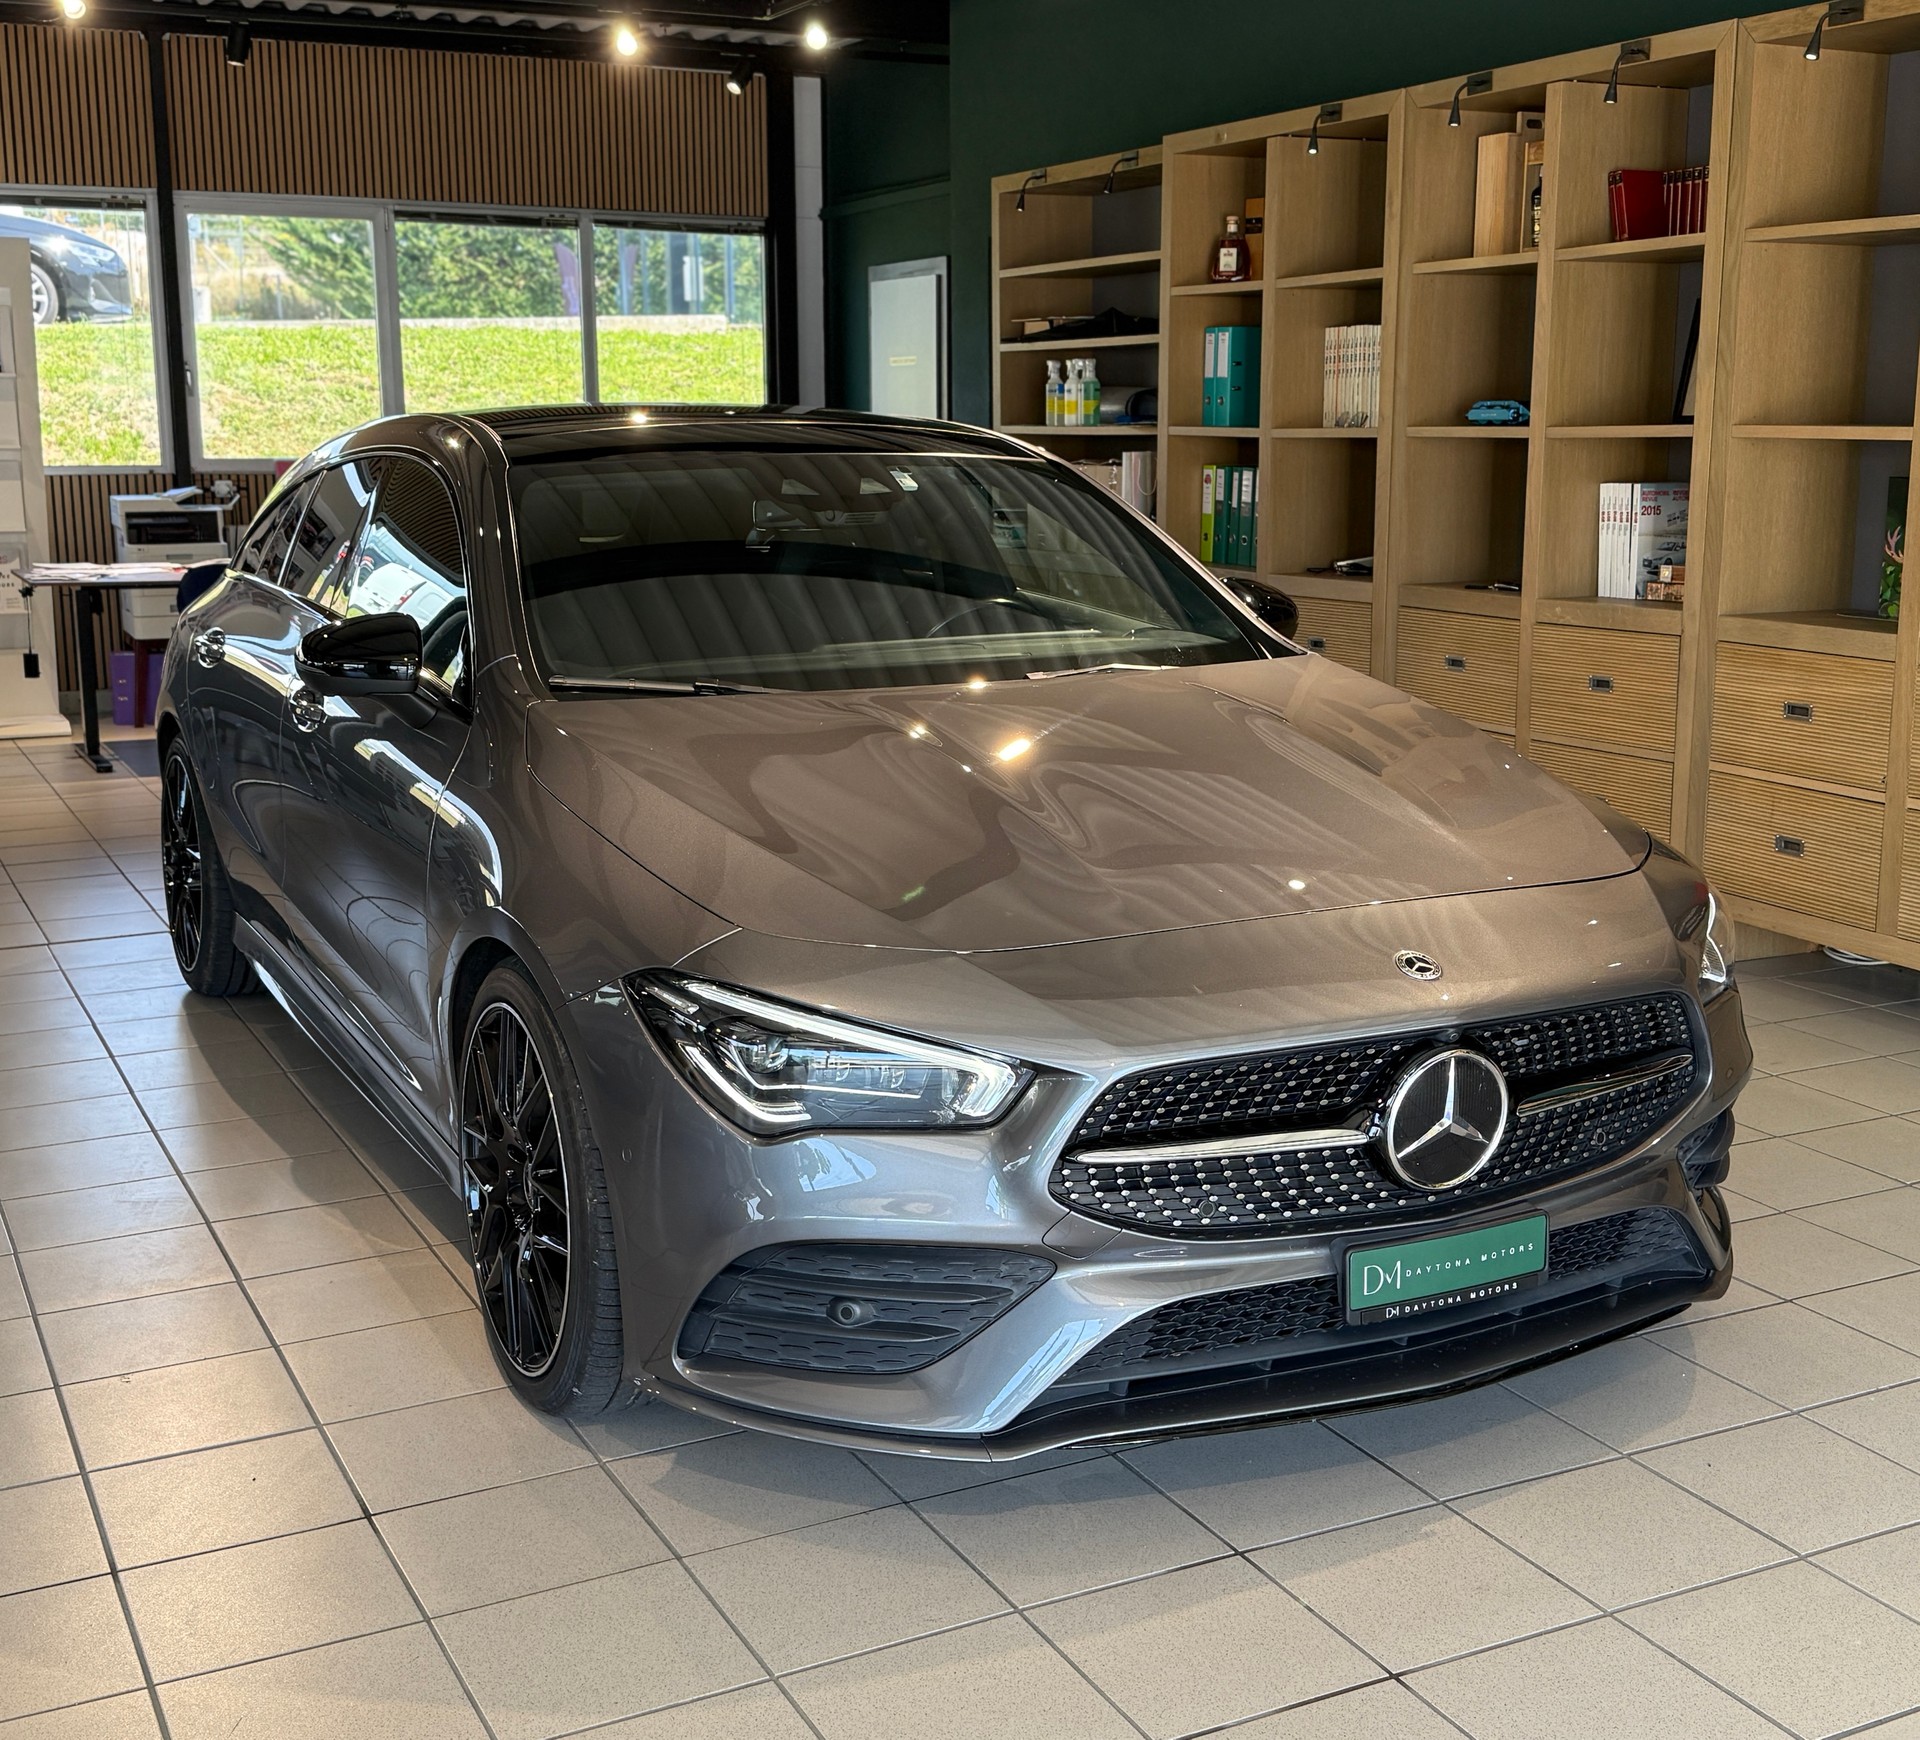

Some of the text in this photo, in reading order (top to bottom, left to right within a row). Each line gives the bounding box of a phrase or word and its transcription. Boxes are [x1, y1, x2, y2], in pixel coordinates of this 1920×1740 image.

[1641, 505, 1662, 516] 2015
[1406, 1258, 1471, 1278] DAYTONA
[1481, 1243, 1534, 1262] MOTORS
[1405, 1295, 1462, 1313] DAYTONA
[1470, 1282, 1518, 1299] MOTORS
